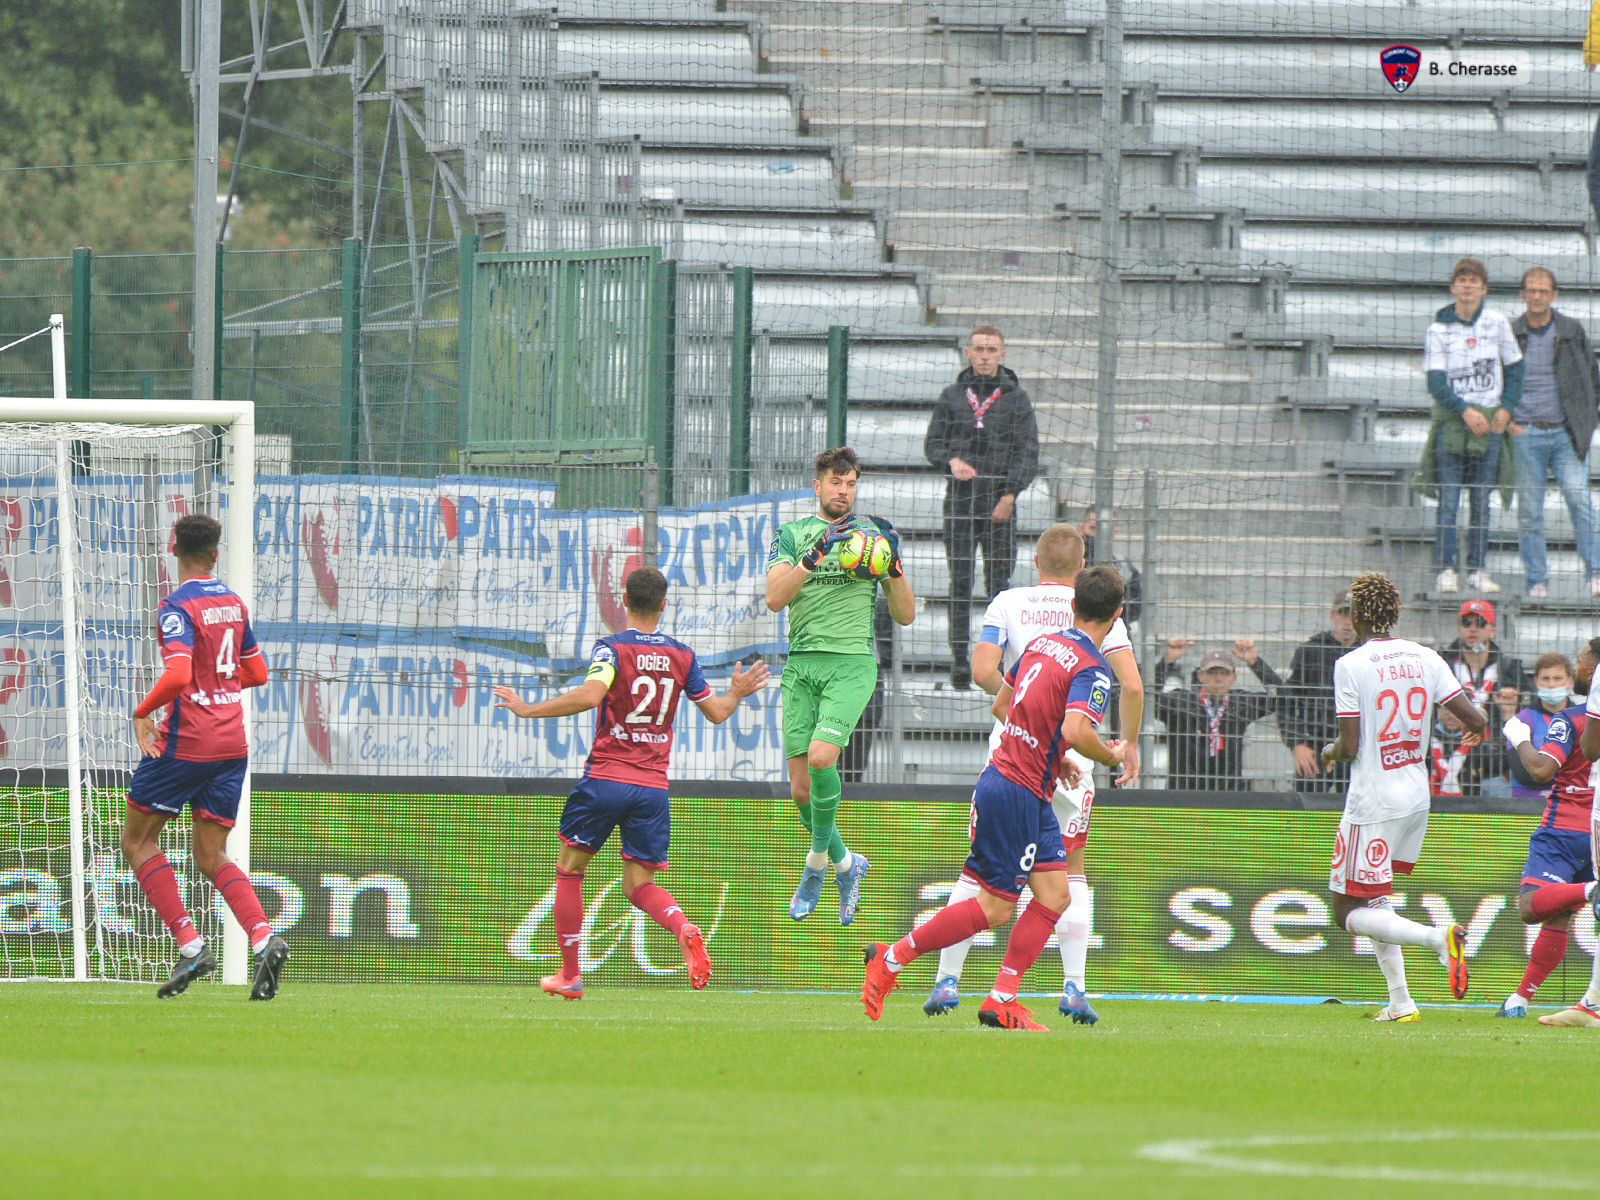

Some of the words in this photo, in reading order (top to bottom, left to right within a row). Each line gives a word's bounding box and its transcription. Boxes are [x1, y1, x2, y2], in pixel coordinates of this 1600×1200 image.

[861, 535, 874, 567] uhlsport
[1020, 609, 1074, 628] CHARDON
[216, 628, 236, 679] 4
[636, 651, 670, 672] OGIER
[624, 675, 675, 726] 21
[1375, 686, 1427, 743] 29
[1019, 842, 1038, 872] 8
